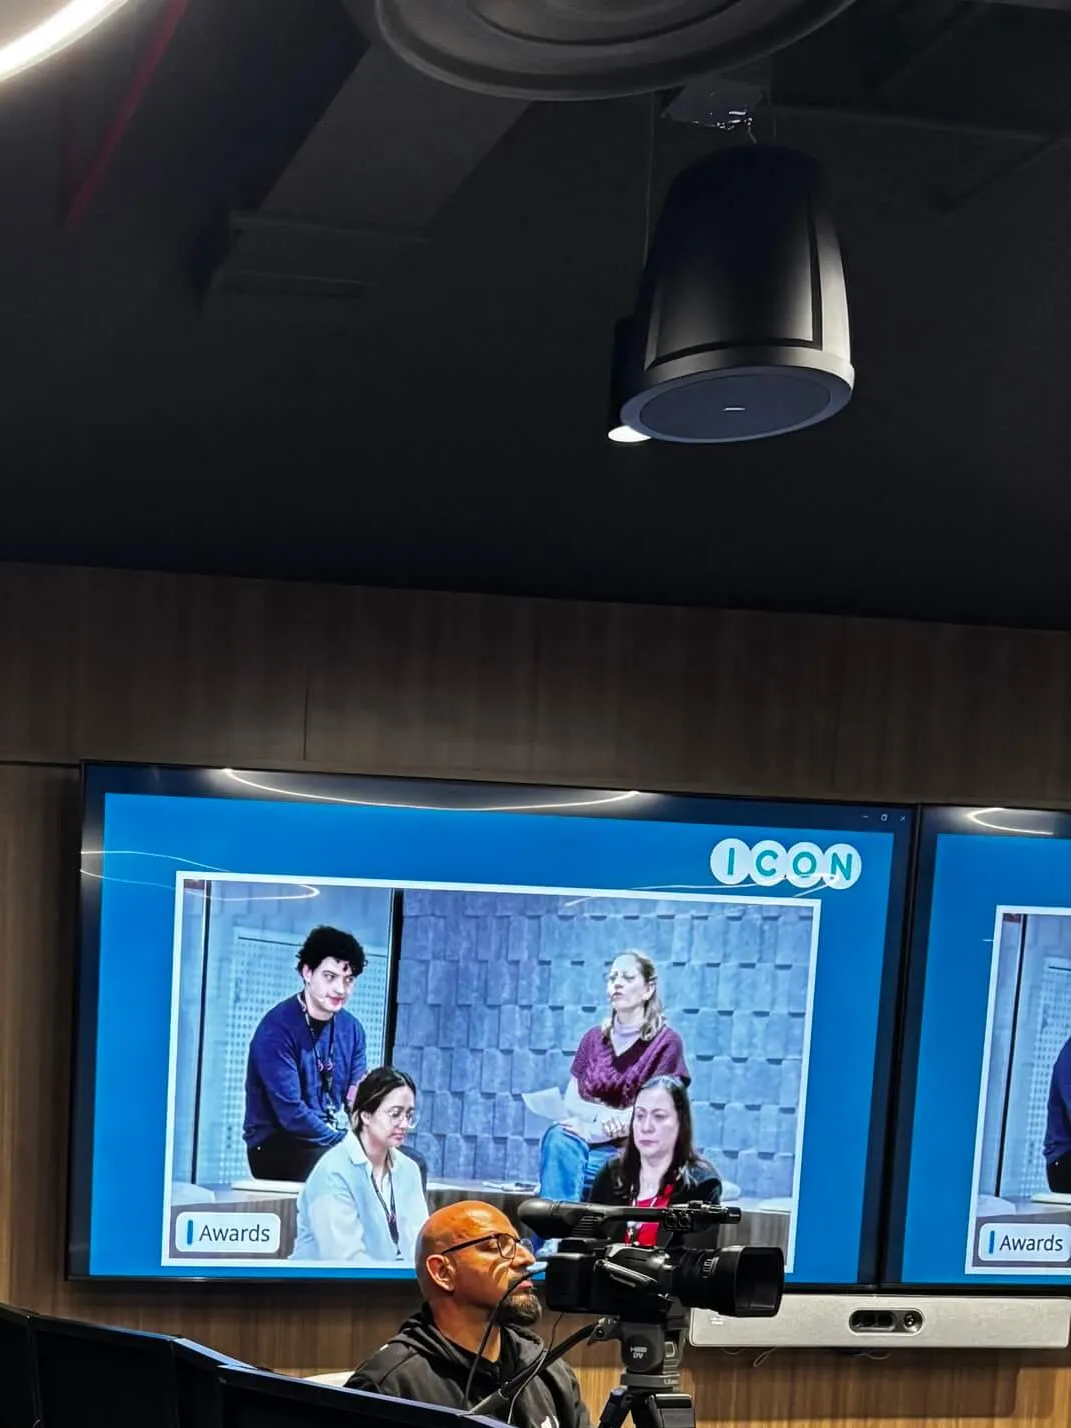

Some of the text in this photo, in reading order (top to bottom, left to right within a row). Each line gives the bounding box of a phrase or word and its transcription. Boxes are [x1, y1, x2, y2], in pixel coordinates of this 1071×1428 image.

[720, 843, 857, 885] ICON
[198, 1224, 270, 1242] Awards
[999, 1234, 1063, 1251] Awards
